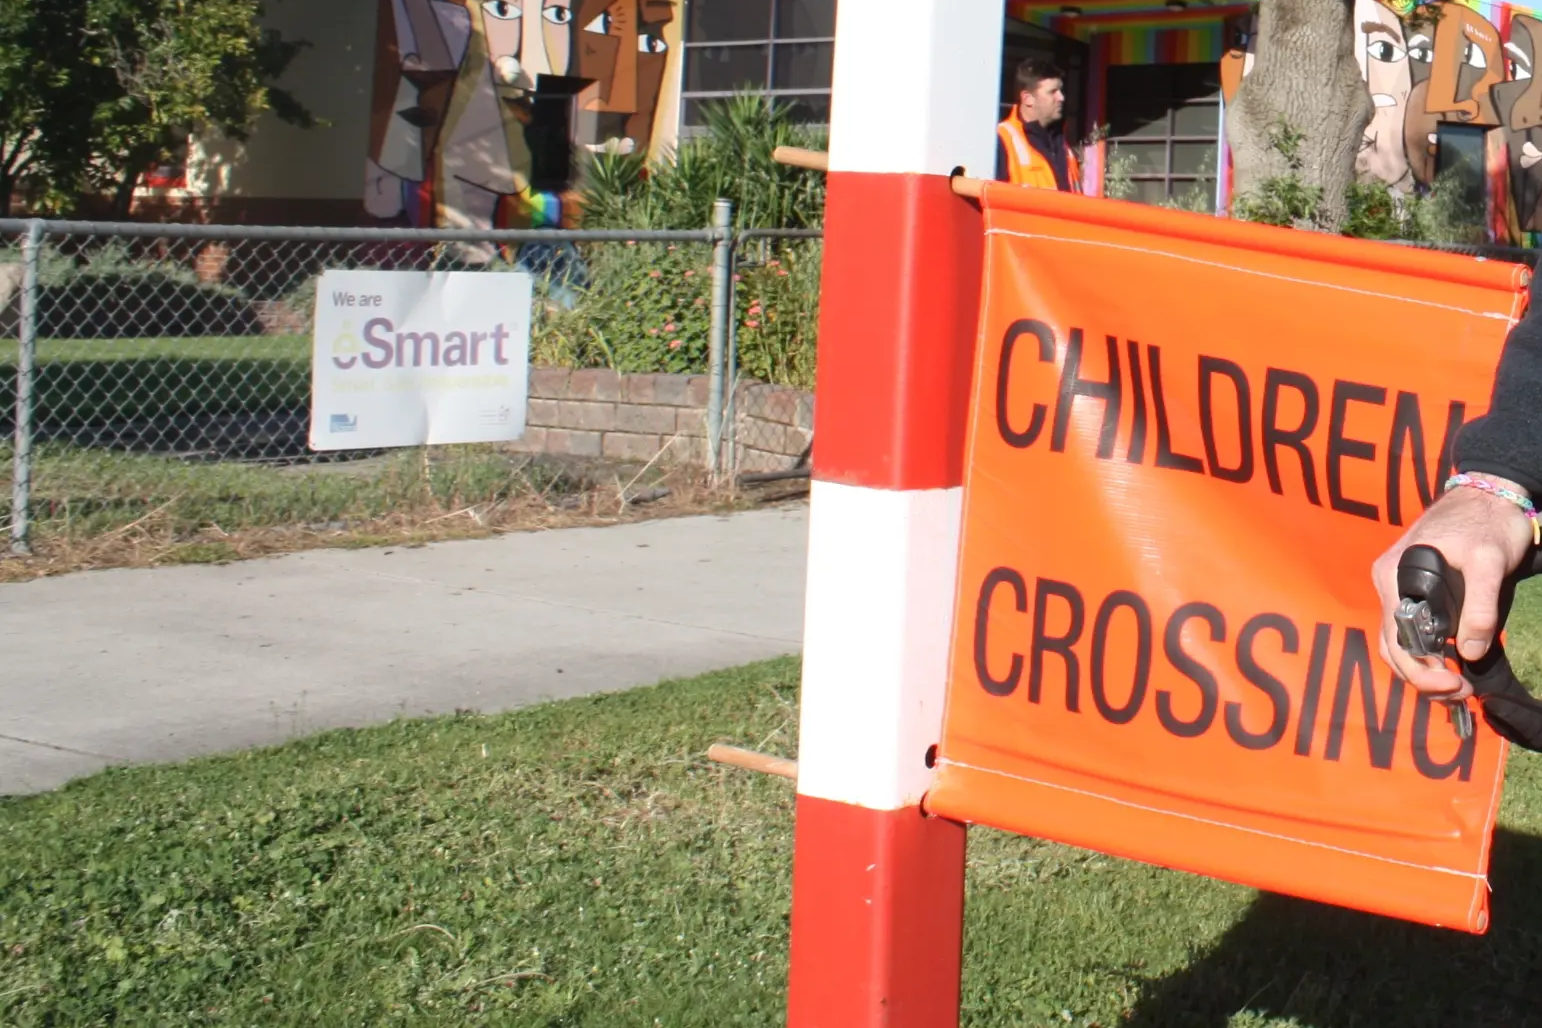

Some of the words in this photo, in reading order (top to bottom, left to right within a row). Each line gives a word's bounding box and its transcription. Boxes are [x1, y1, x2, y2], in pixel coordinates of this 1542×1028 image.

[332, 291, 356, 307] We
[358, 294, 382, 307] are
[995, 318, 1466, 527] CHILDREN
